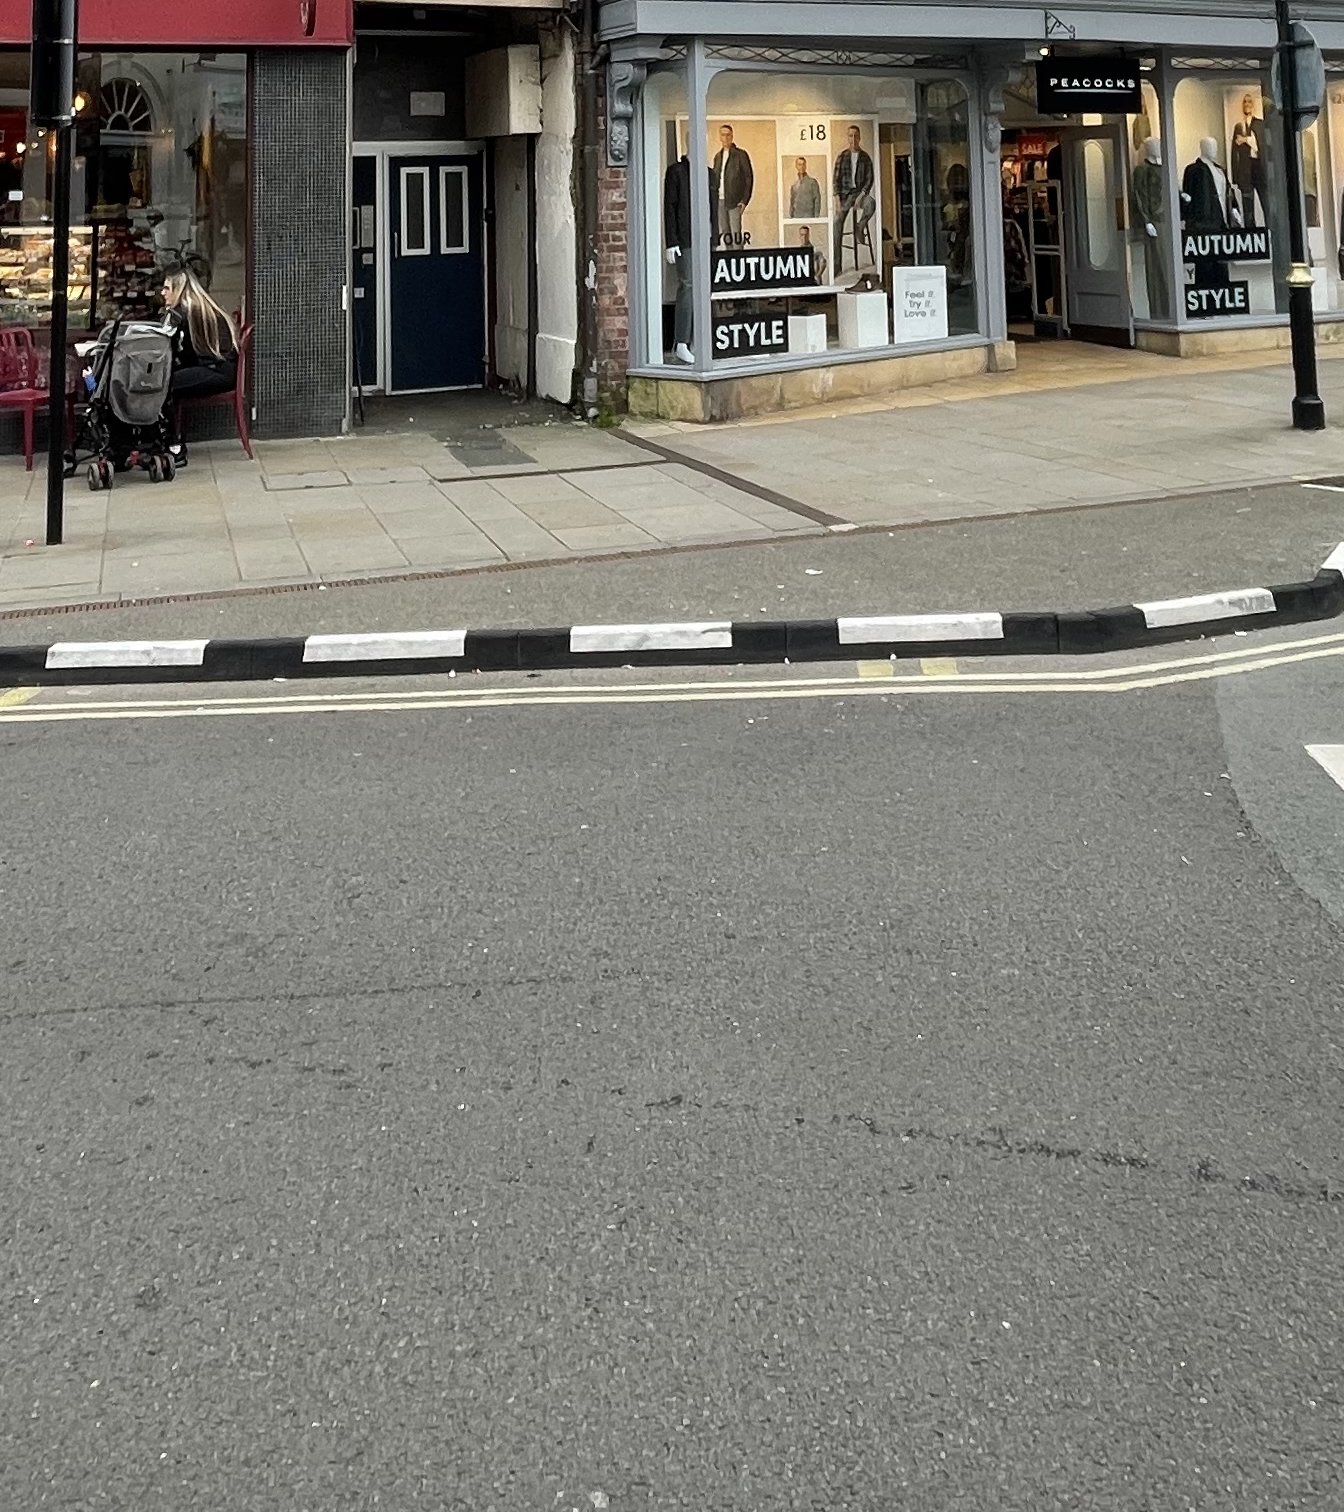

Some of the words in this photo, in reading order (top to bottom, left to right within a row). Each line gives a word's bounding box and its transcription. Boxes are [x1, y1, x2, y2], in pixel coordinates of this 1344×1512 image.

[1049, 77, 1136, 88] PEACOCKS
[800, 124, 827, 141] £18
[1183, 232, 1266, 257] AUTUMN
[713, 254, 811, 284] AUTUMN
[1187, 287, 1246, 311] STYLE
[715, 320, 785, 350] STYLE
